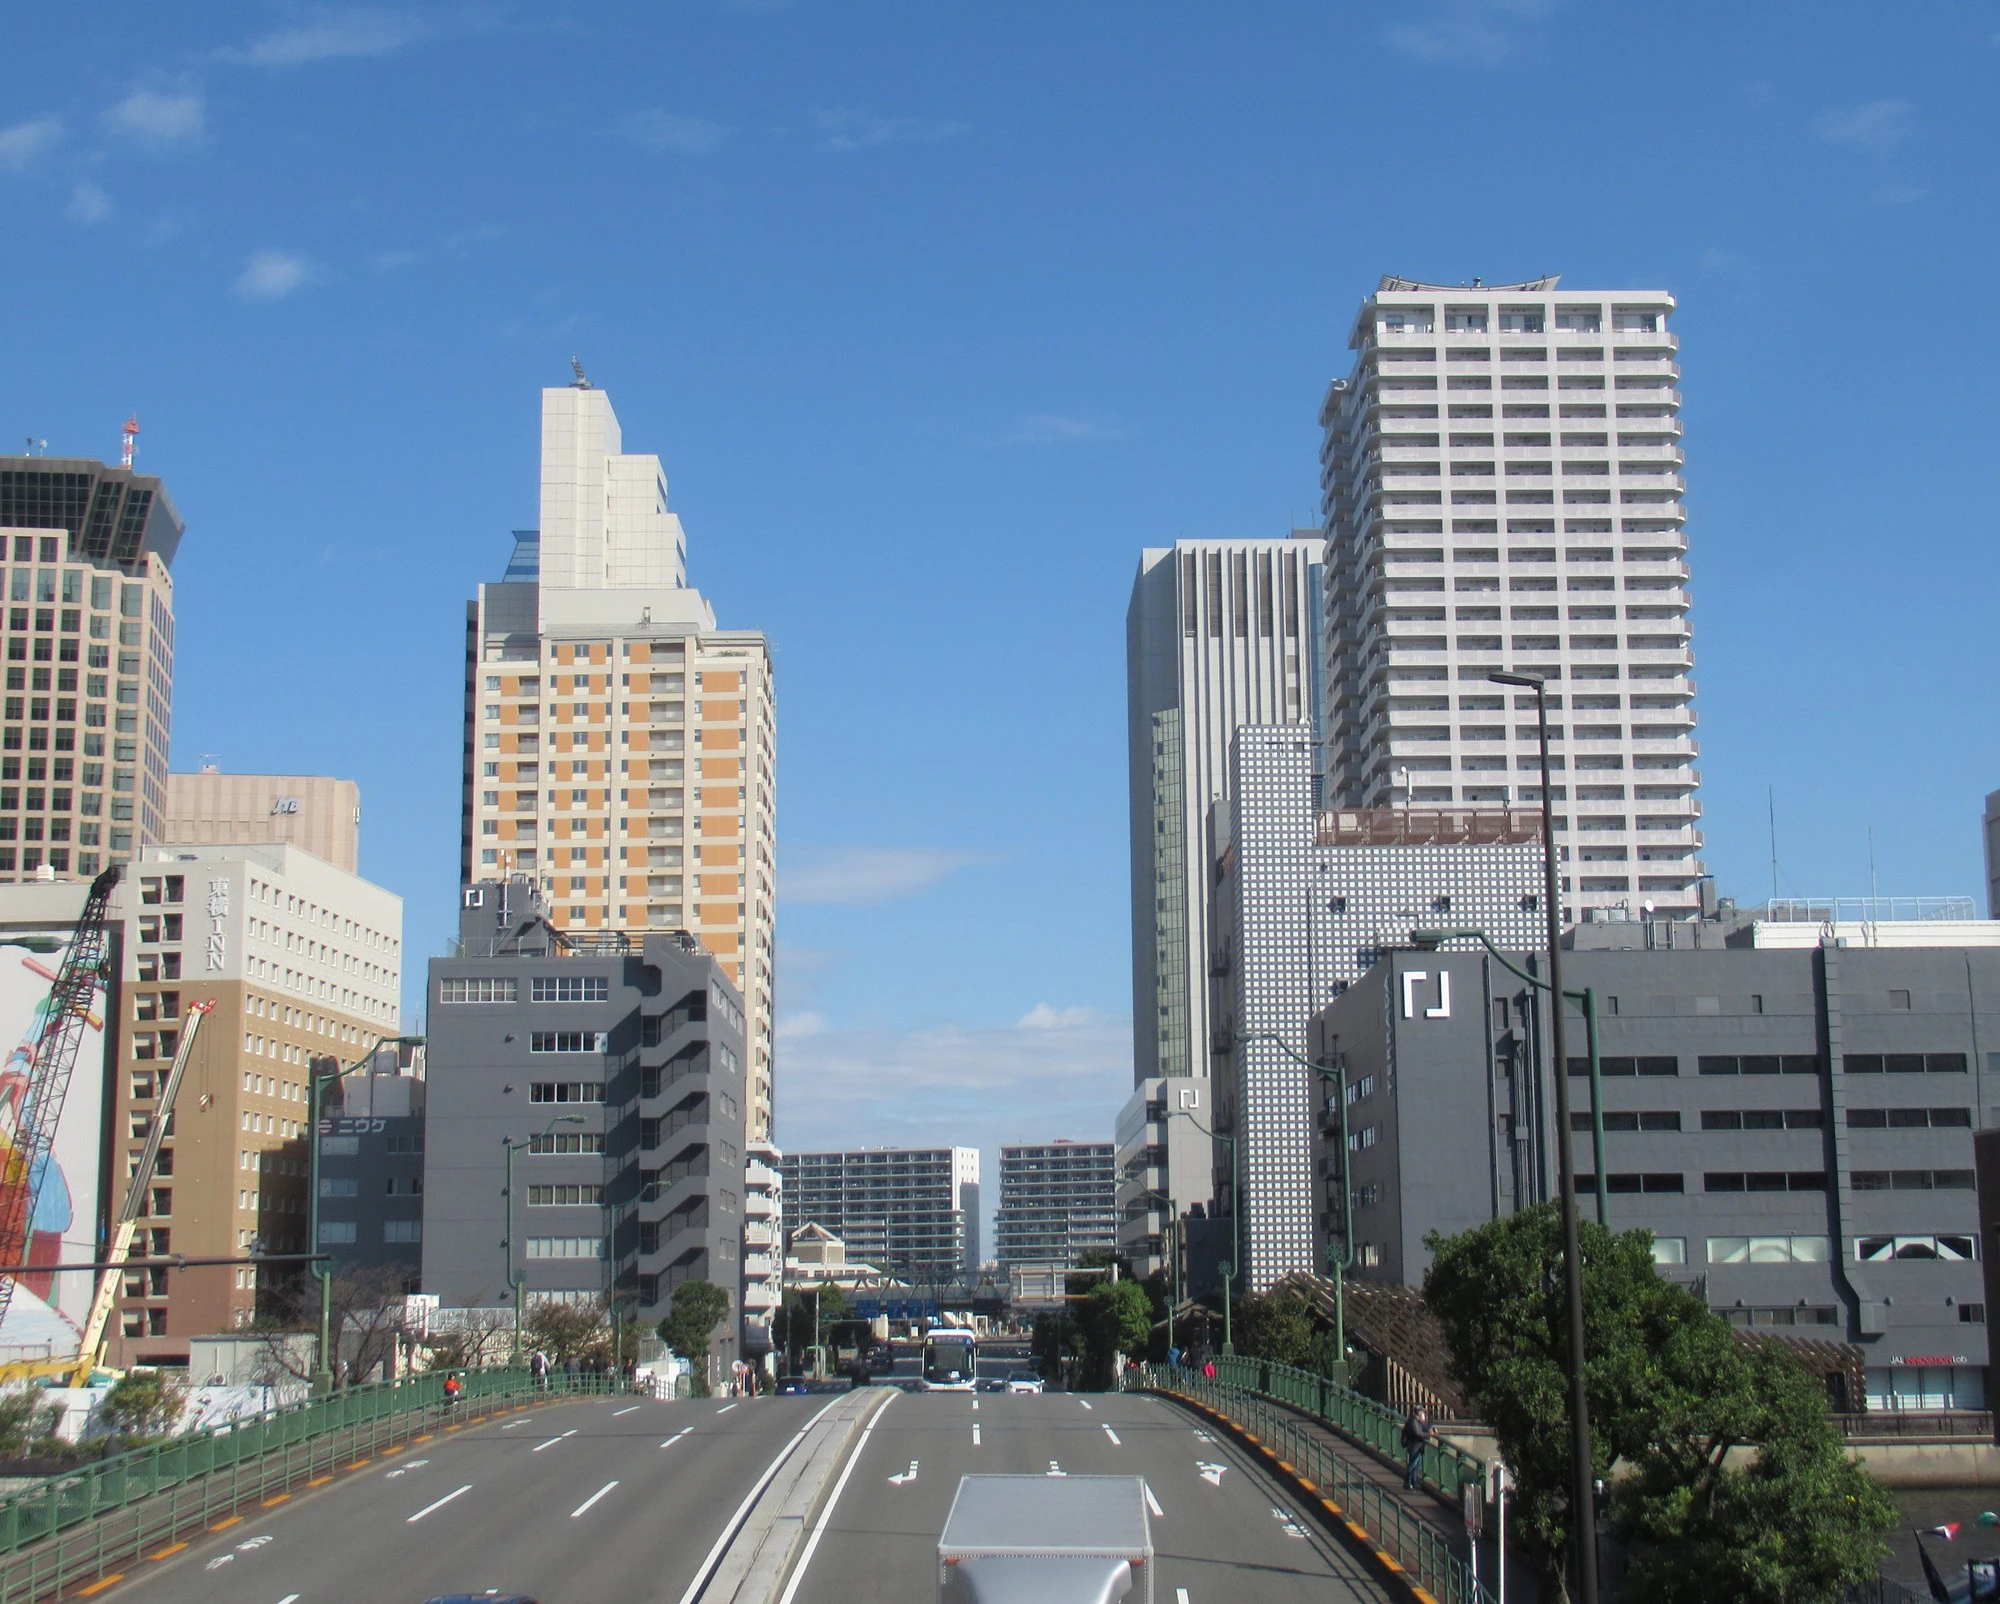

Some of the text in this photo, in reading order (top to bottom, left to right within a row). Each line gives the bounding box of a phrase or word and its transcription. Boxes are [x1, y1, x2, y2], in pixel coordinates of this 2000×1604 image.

[206, 876, 229, 971] 東横INN
[1891, 1355, 1967, 1365] JAL INNOVATION Lab
